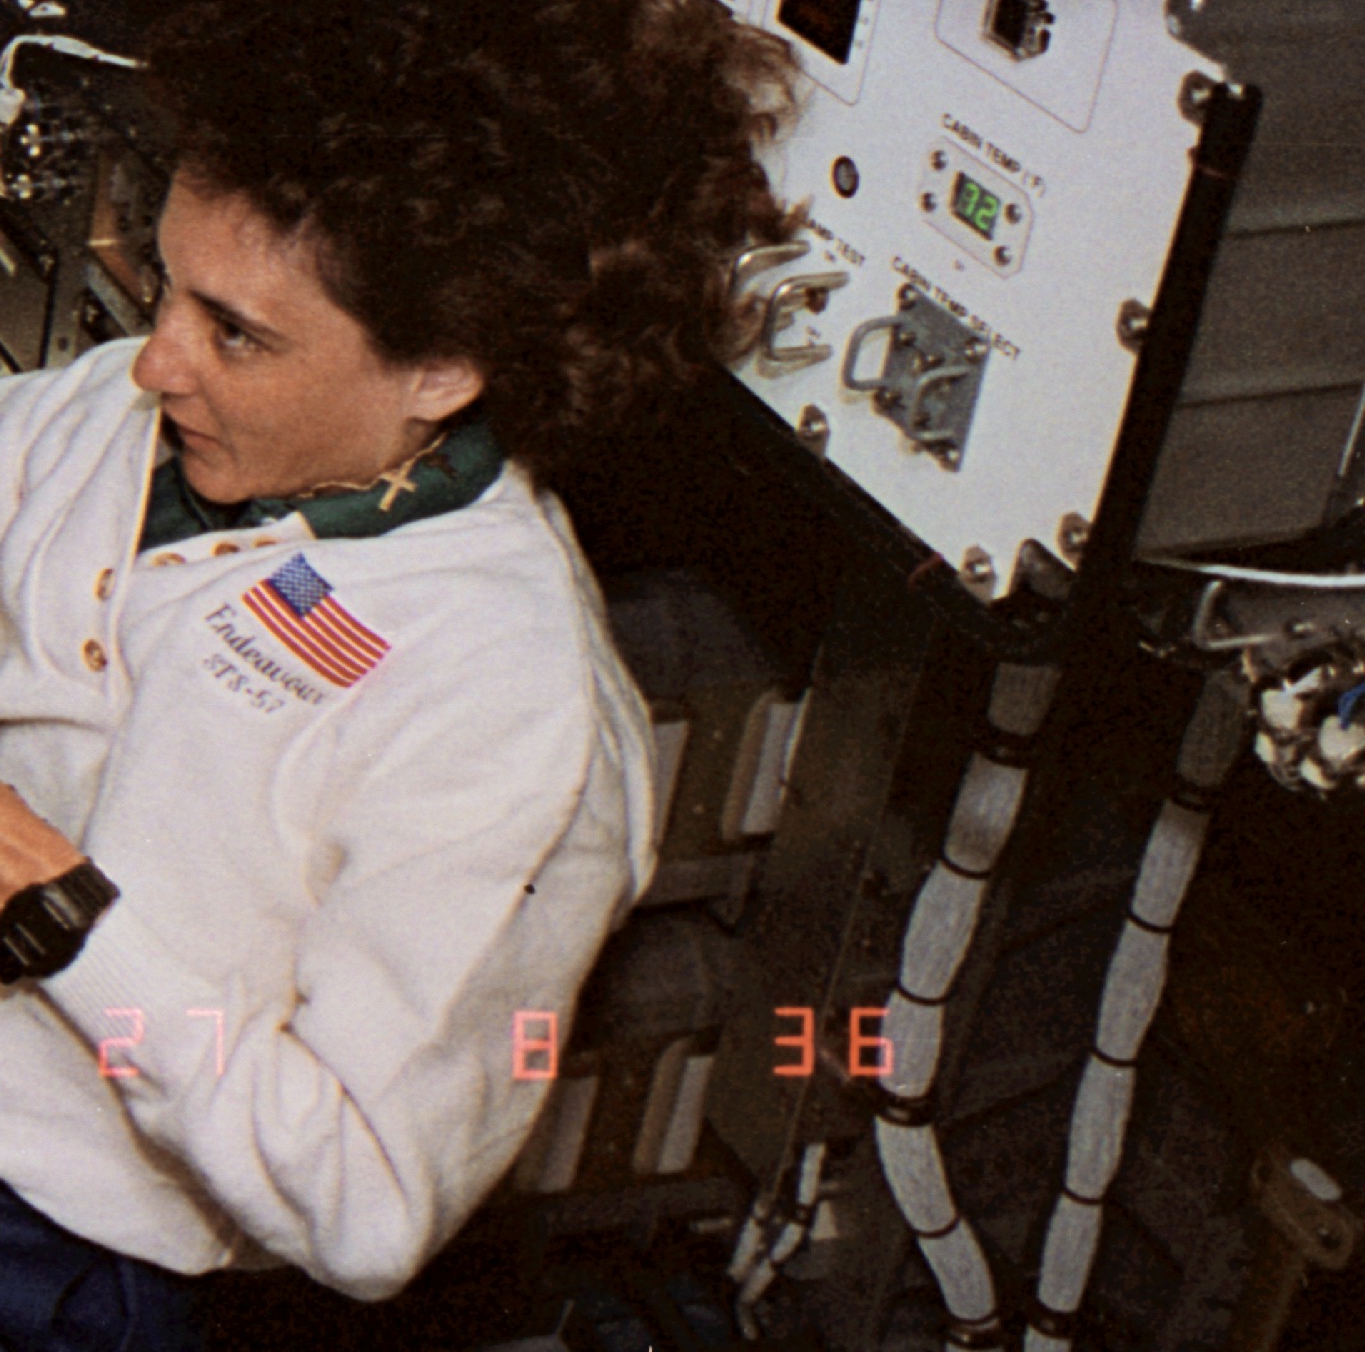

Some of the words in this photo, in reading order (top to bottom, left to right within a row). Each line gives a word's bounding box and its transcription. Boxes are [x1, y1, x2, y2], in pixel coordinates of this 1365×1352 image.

[941, 112, 983, 150] CABIN
[985, 141, 1022, 173] TEMP
[963, 181, 999, 231] 72
[836, 238, 866, 267] TEST
[891, 254, 932, 292] CABIN
[933, 285, 969, 317] TEMP
[969, 313, 1022, 360] SELECT
[202, 651, 286, 715] STS-57
[205, 602, 326, 706] Endeavour
